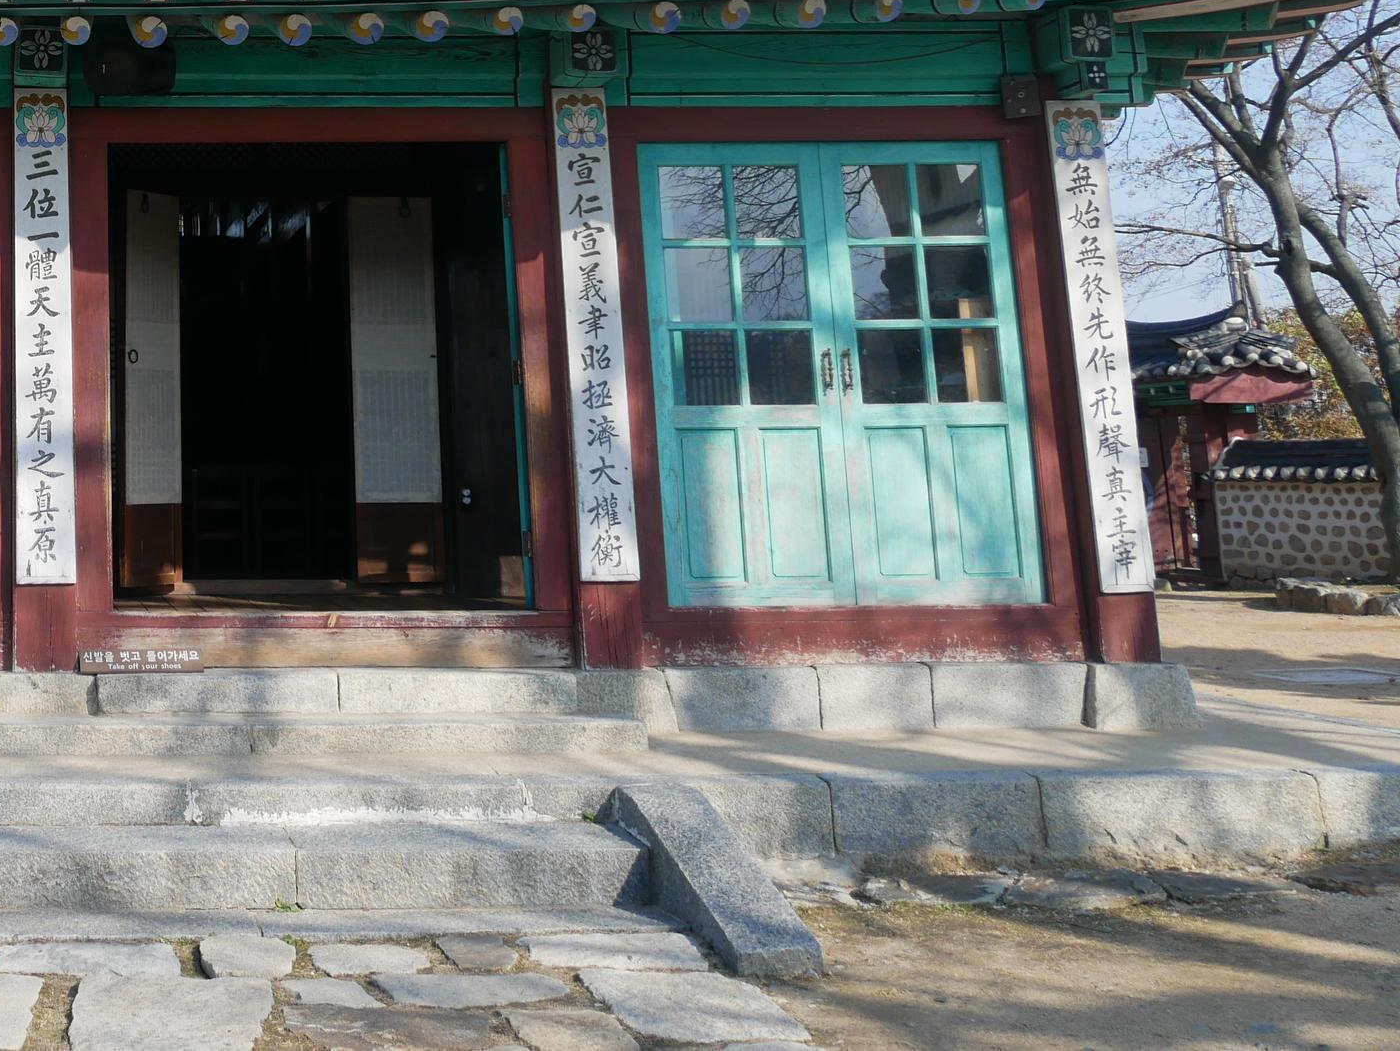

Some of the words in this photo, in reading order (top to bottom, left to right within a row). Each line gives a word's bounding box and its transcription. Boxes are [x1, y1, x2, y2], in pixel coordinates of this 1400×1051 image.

[83, 651, 114, 663] 신발을
[120, 651, 141, 662] 벗고
[146, 650, 199, 661] 들어가세요
